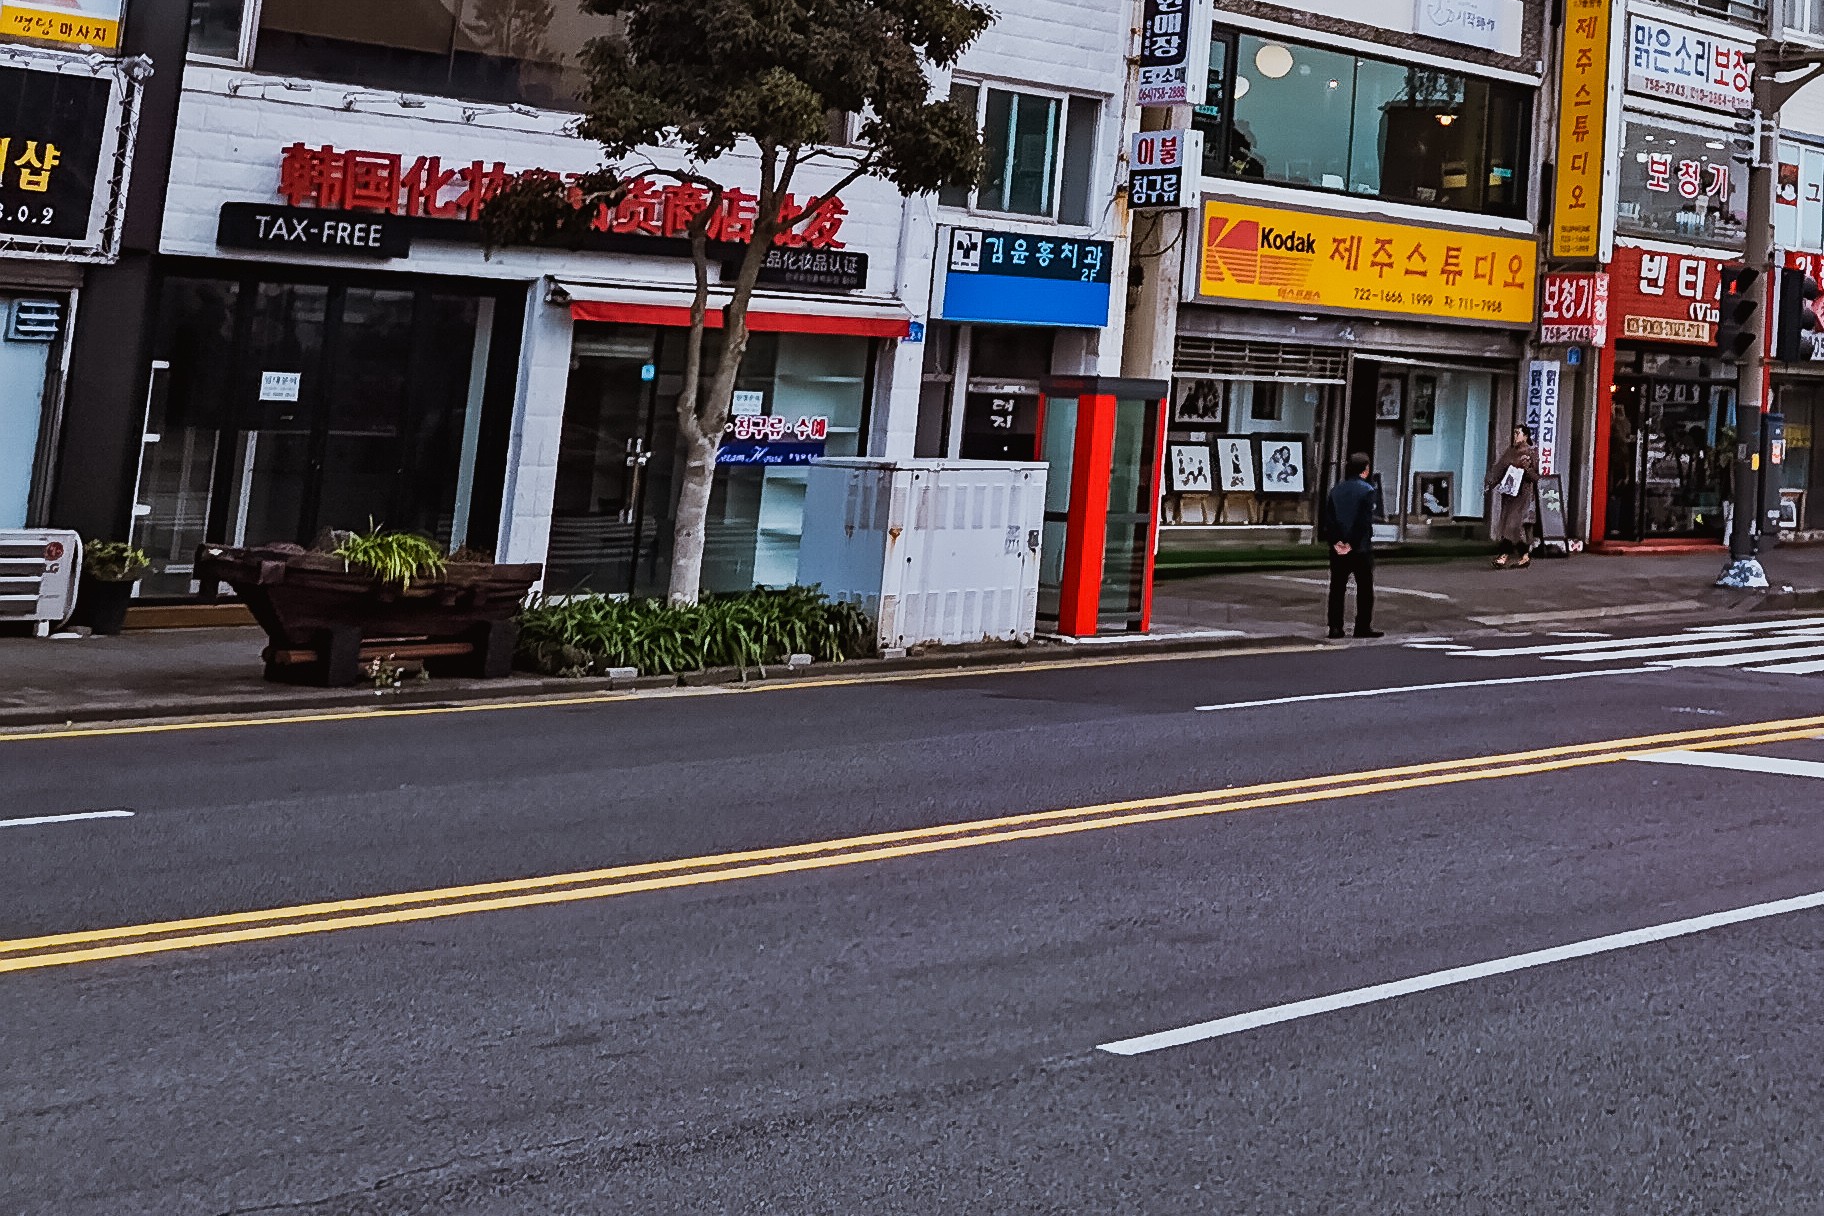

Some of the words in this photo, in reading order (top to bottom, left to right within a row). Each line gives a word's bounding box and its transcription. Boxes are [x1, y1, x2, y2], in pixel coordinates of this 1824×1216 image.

[60, 22, 107, 42] 마사지
[1634, 24, 1711, 83] 맑은소리
[1569, 15, 1598, 210] 제주스튜디오
[0, 137, 61, 192] 샵
[1137, 136, 1177, 166] 이불
[1647, 153, 1729, 202] 보청기
[254, 214, 383, 249] TAX-FREE
[1261, 227, 1316, 255] Kodak
[761, 249, 859, 275] 品化妆品认证
[985, 237, 1103, 270] 김윤홍치과
[1329, 235, 1525, 290] 제주스튜디오
[1081, 269, 1097, 282] 2F
[1640, 254, 1721, 301] 빈티
[1543, 277, 1594, 319] 보청기
[1689, 302, 1720, 323] (Vin
